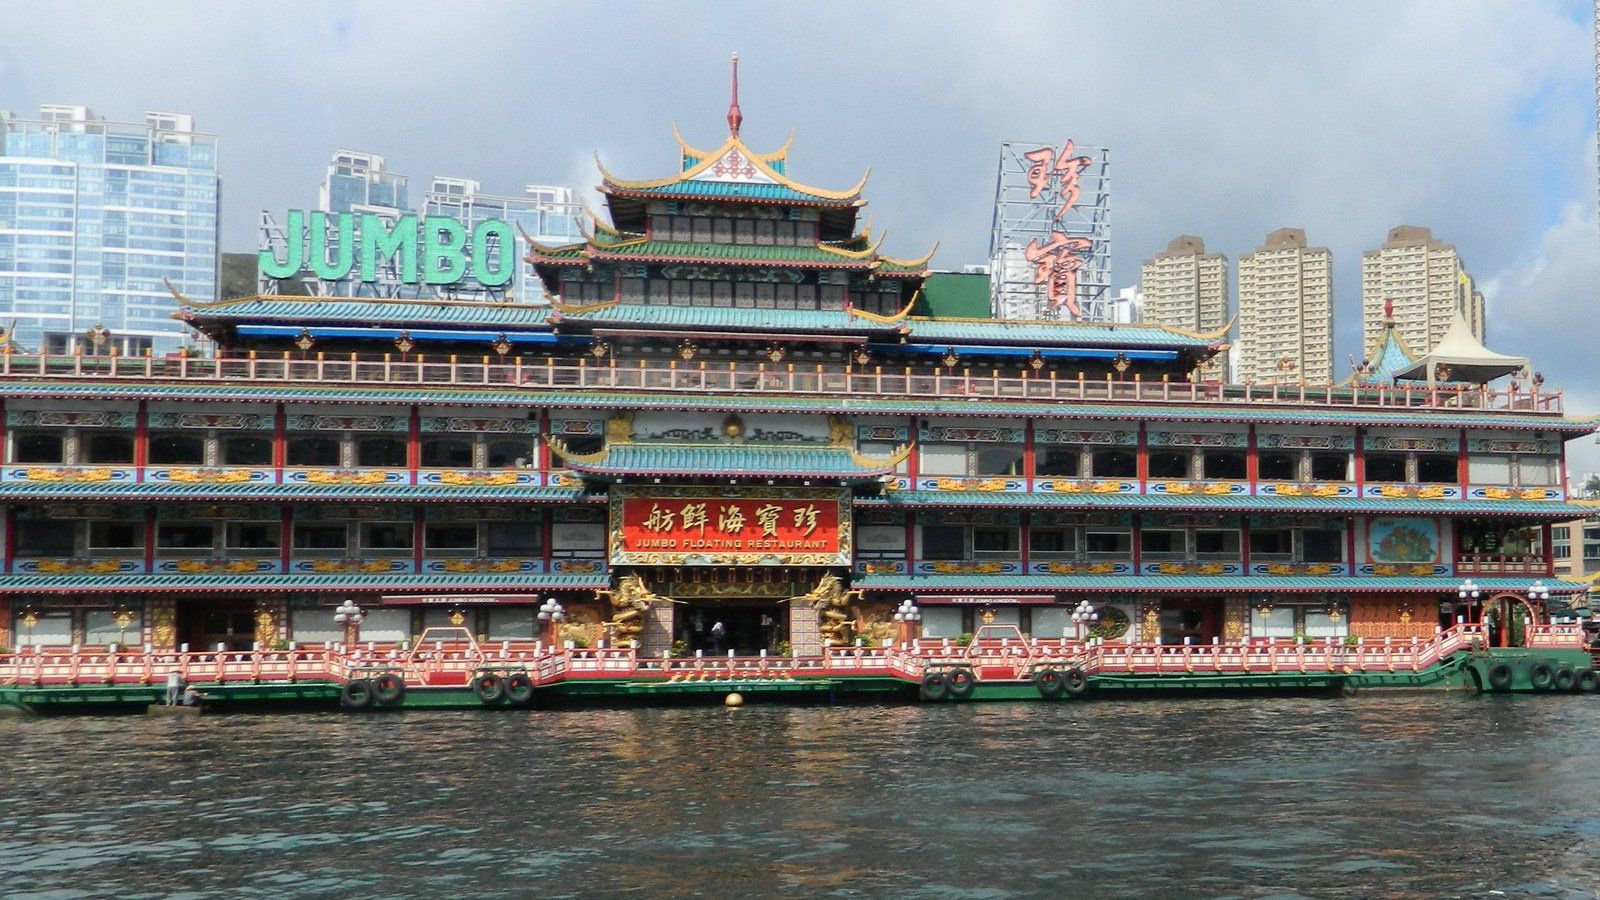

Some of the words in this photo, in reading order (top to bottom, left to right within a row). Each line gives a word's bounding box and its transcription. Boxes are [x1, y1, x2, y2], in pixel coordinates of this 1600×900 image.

[258, 209, 516, 287] JUMBO
[1023, 139, 1093, 317] 珍寶
[636, 538, 677, 549] JUMBO
[683, 538, 742, 549] FLOATING
[747, 538, 828, 549] RESTAURANT
